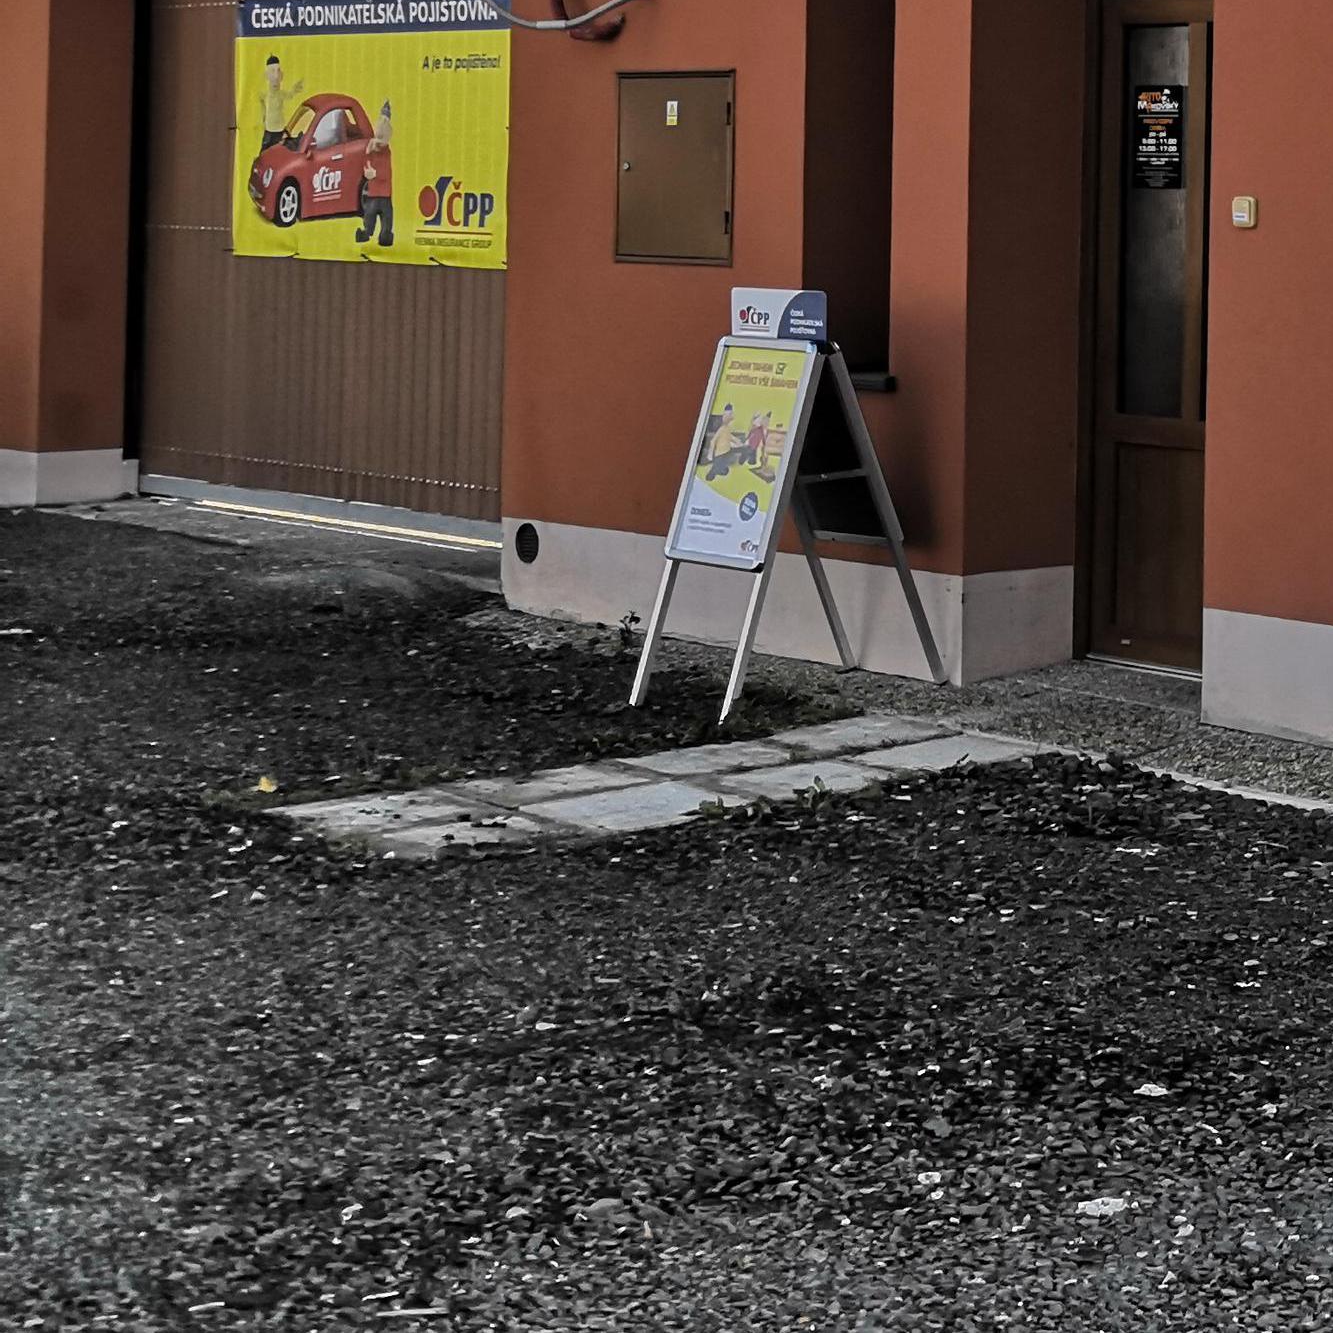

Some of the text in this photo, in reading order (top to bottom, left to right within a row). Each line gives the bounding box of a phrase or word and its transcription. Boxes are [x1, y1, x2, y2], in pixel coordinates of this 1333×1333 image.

[251, 2, 295, 28] ČESKÁ
[423, 56, 429, 69] A
[447, 181, 494, 227] ČPP
[751, 307, 770, 325] ČPP
